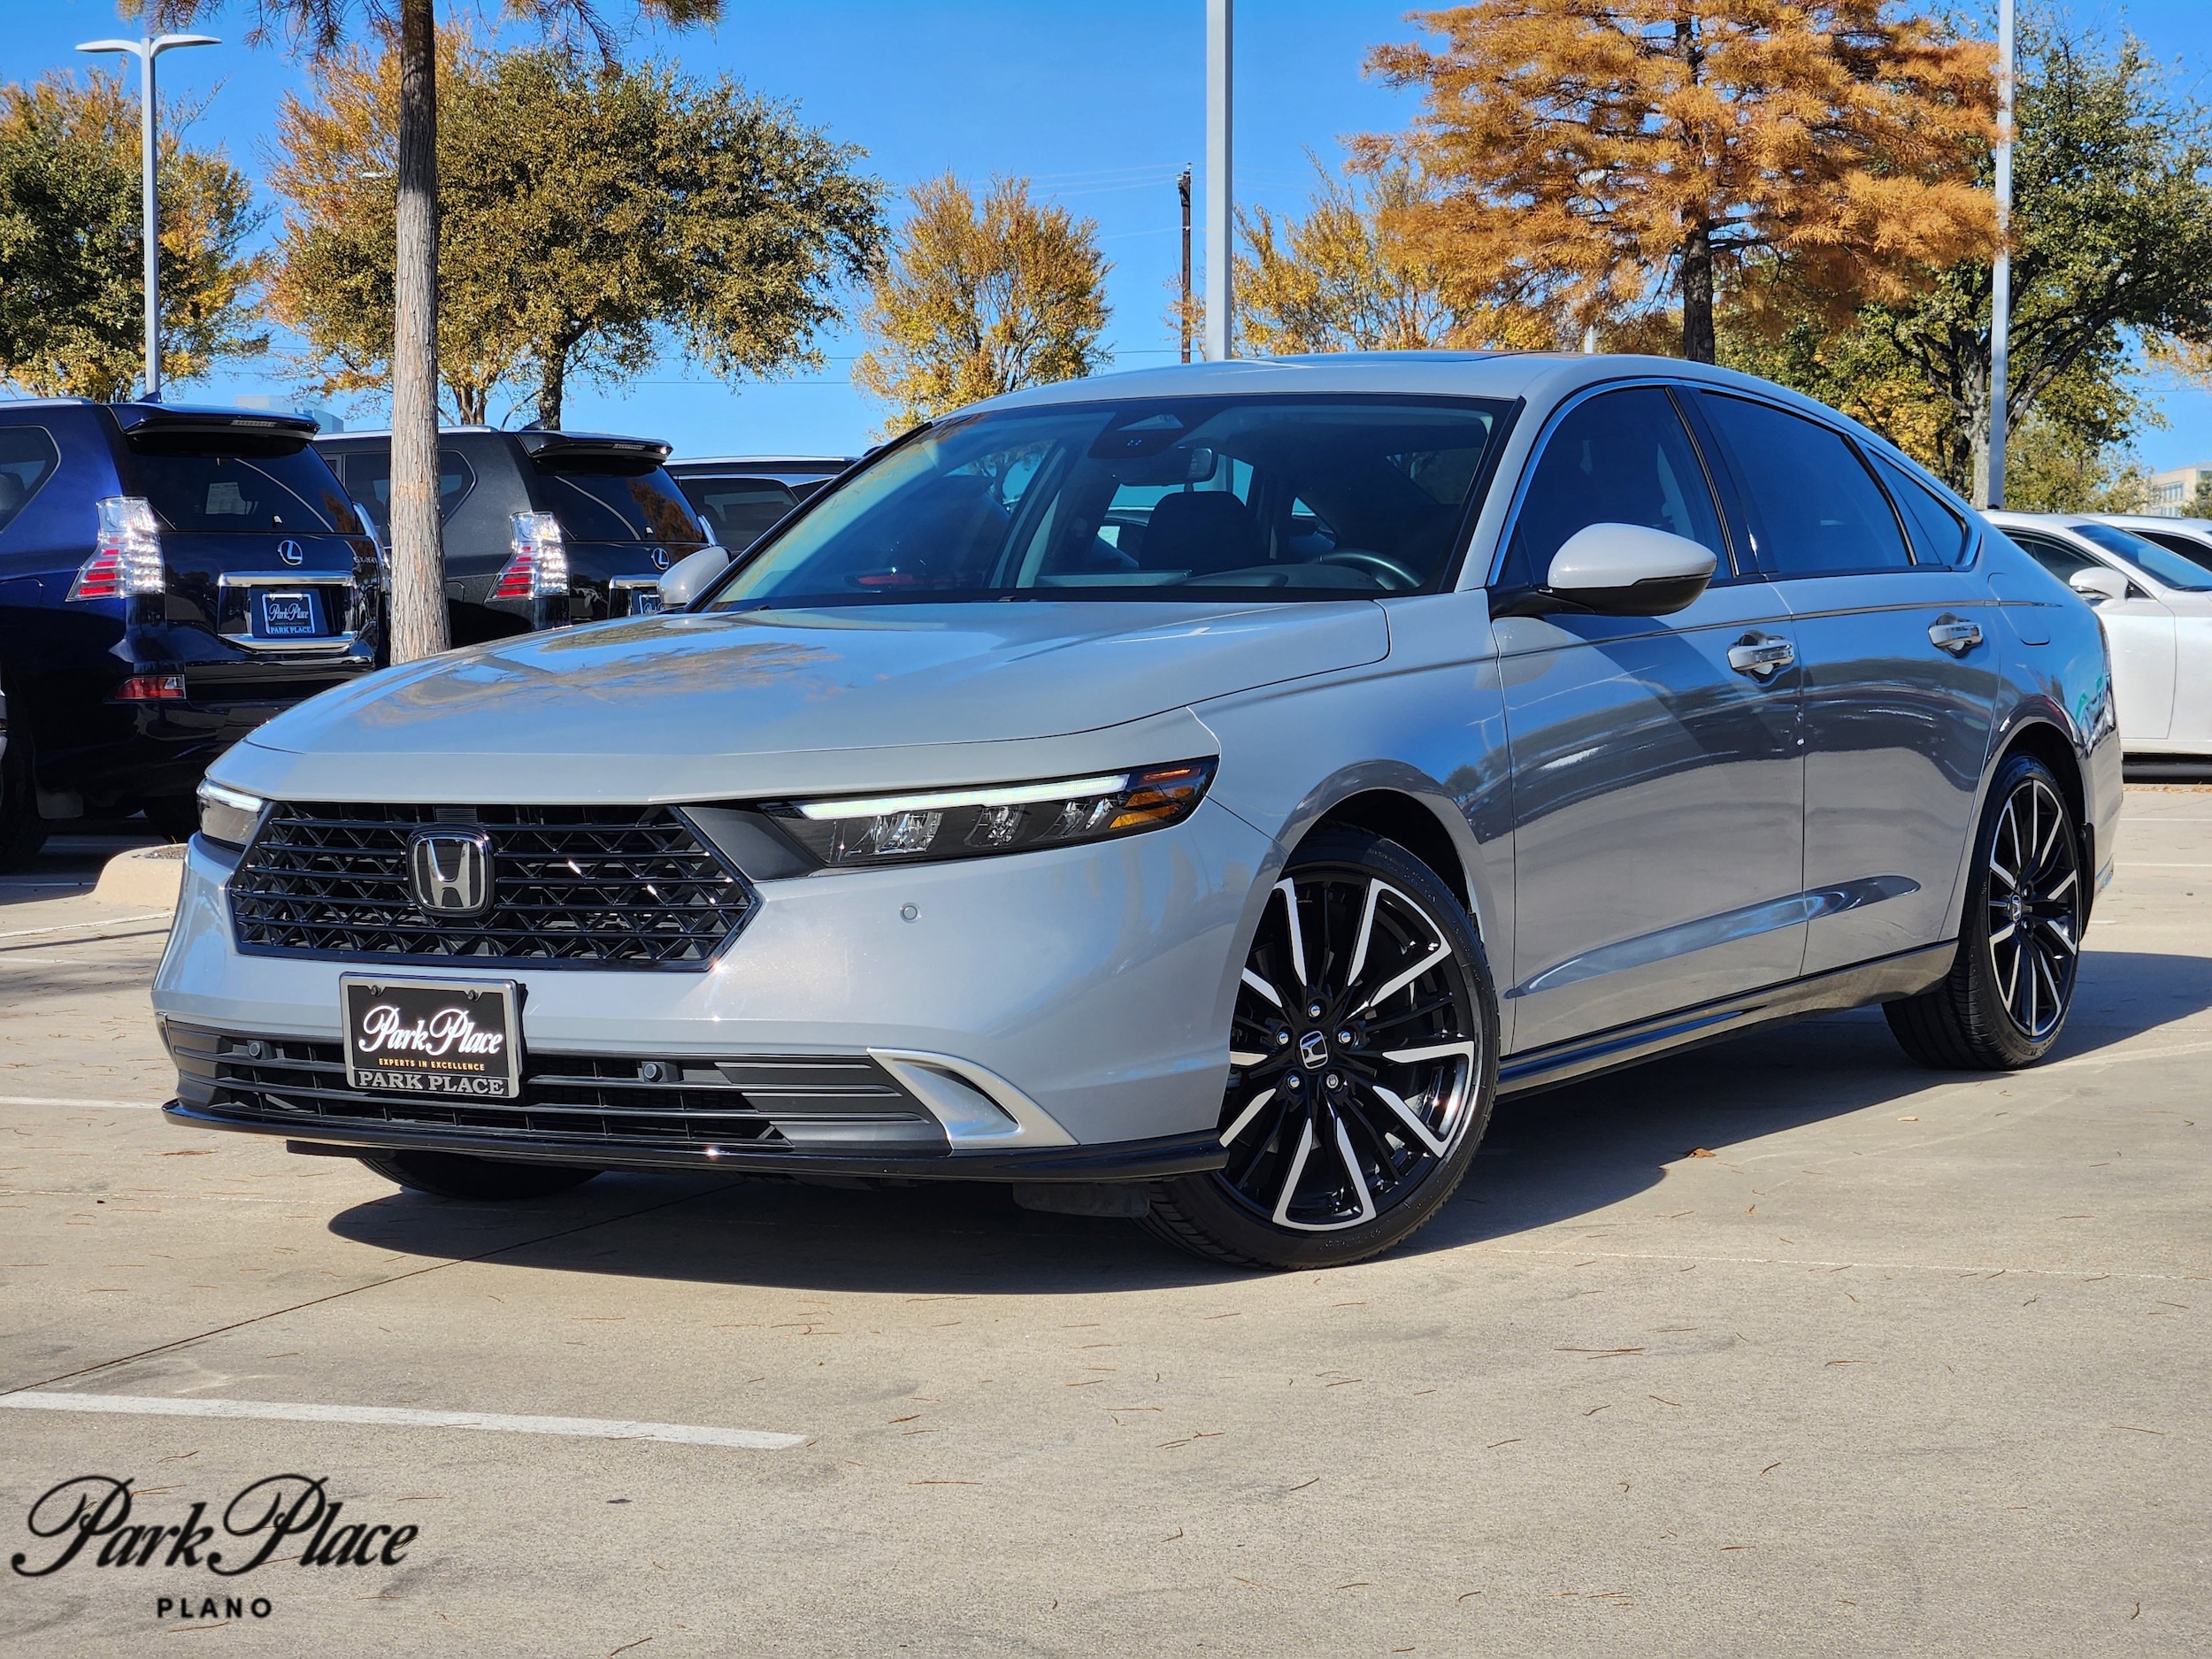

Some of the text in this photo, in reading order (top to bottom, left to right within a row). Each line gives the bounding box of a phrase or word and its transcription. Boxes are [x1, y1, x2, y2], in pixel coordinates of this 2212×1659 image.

[268, 603, 309, 621] Park Place
[270, 626, 312, 634] PARK PLACE
[357, 1004, 503, 1056] Park Place
[378, 1057, 486, 1071] EXPERTS IN EXCELLENCE
[357, 1071, 505, 1095] PARK PLACE
